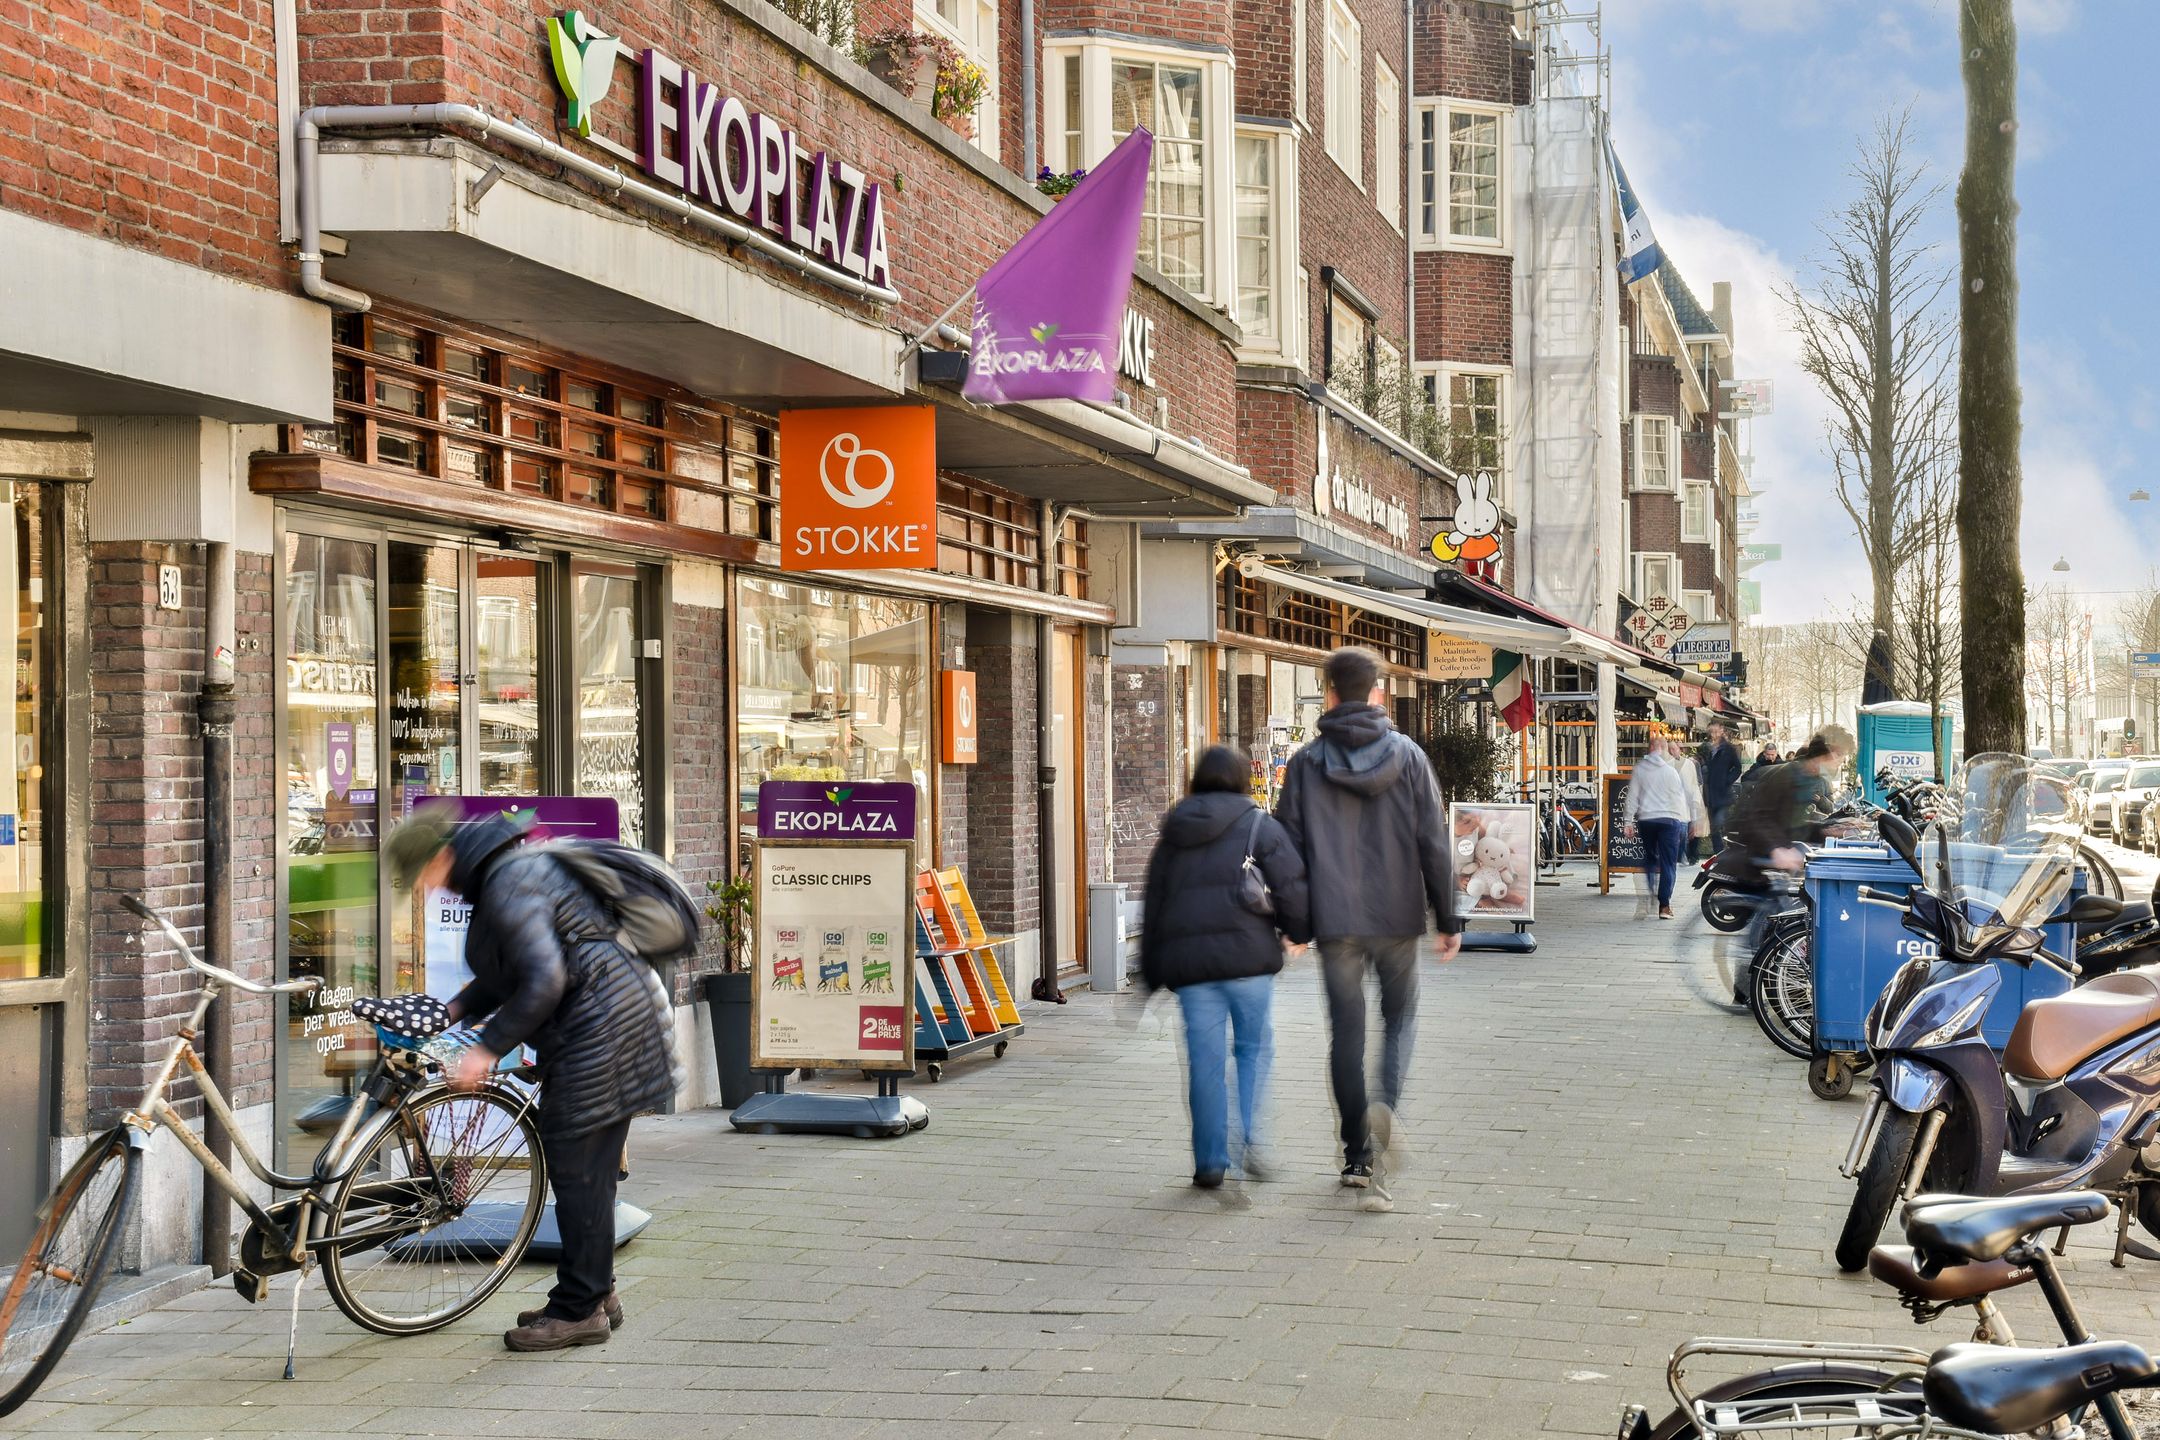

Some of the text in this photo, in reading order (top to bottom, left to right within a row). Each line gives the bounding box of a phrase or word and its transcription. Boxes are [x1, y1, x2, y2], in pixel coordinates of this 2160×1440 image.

[643, 48, 892, 289] EKOPLAZA
[974, 347, 1106, 376] EKOPLAZA
[796, 525, 920, 555] STOKKE
[163, 568, 178, 604] 53
[1650, 596, 1668, 611] 海
[1669, 614, 1687, 631] 酒
[1443, 648, 1477, 656] Maaltijden
[1677, 640, 1729, 652] VLIEGERTJE
[1433, 656, 1458, 664] Belegde
[1137, 701, 1155, 714] 59
[392, 717, 409, 739] 100%
[774, 811, 897, 832] EKOPLAZA
[772, 874, 872, 886] CLASSIC CHIPS
[441, 897, 450, 905] De
[826, 933, 842, 941] GO
[869, 933, 884, 941] GO
[307, 985, 354, 1010] 7 dagen
[303, 1012, 322, 1037] per
[863, 1017, 878, 1038] 2
[316, 1033, 345, 1057] open
